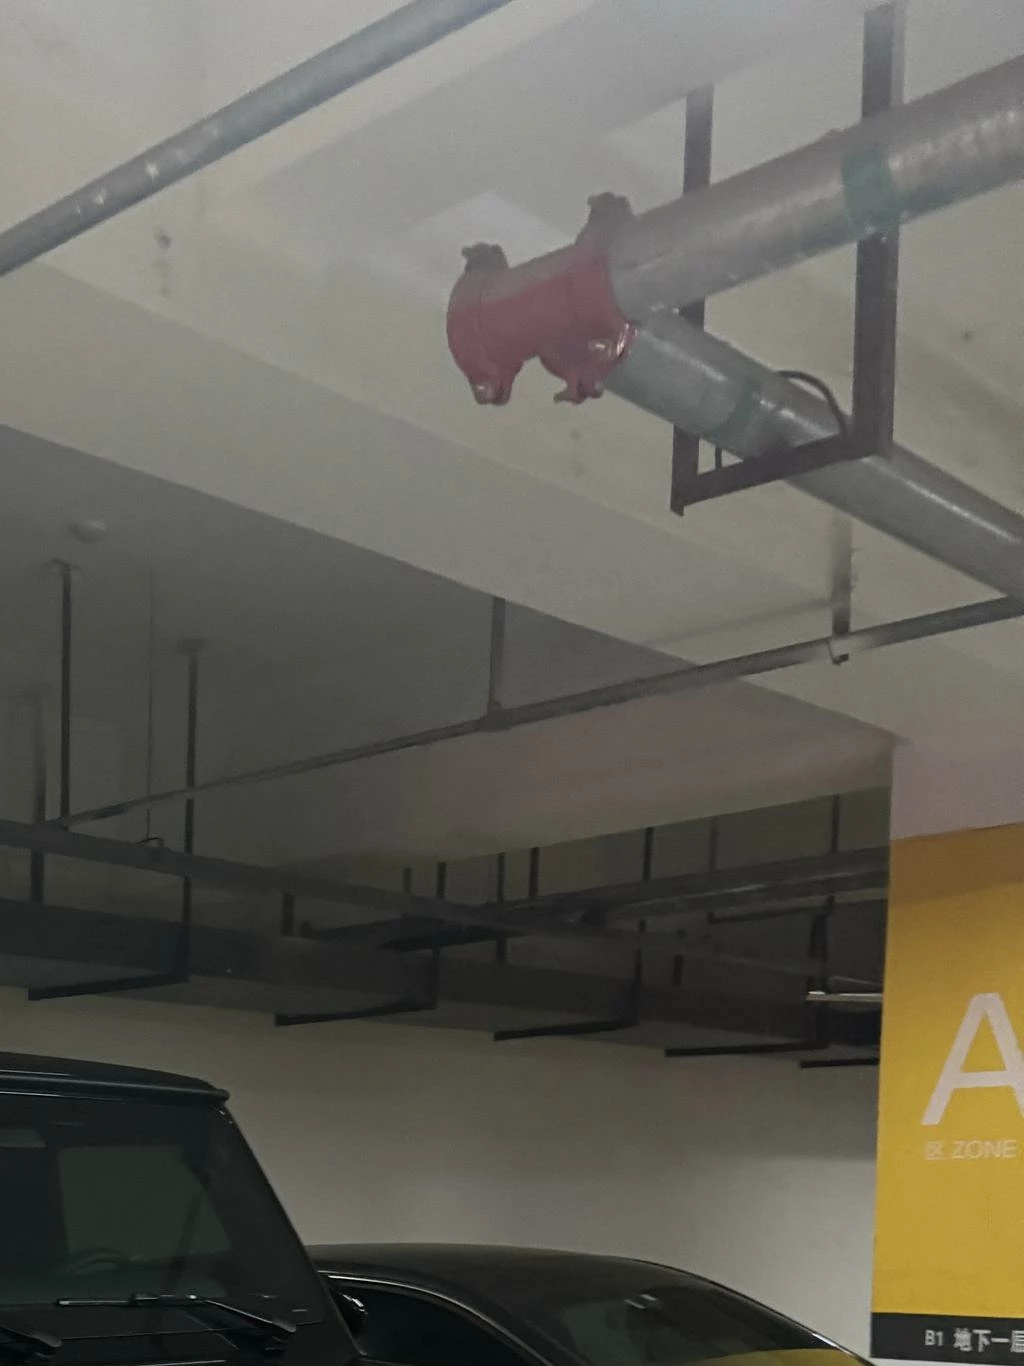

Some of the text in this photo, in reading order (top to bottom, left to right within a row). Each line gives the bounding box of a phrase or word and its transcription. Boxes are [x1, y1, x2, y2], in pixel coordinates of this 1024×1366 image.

[920, 992, 1024, 1126] A
[952, 1139, 1017, 1158] ZONE
[925, 1329, 944, 1346] B1
